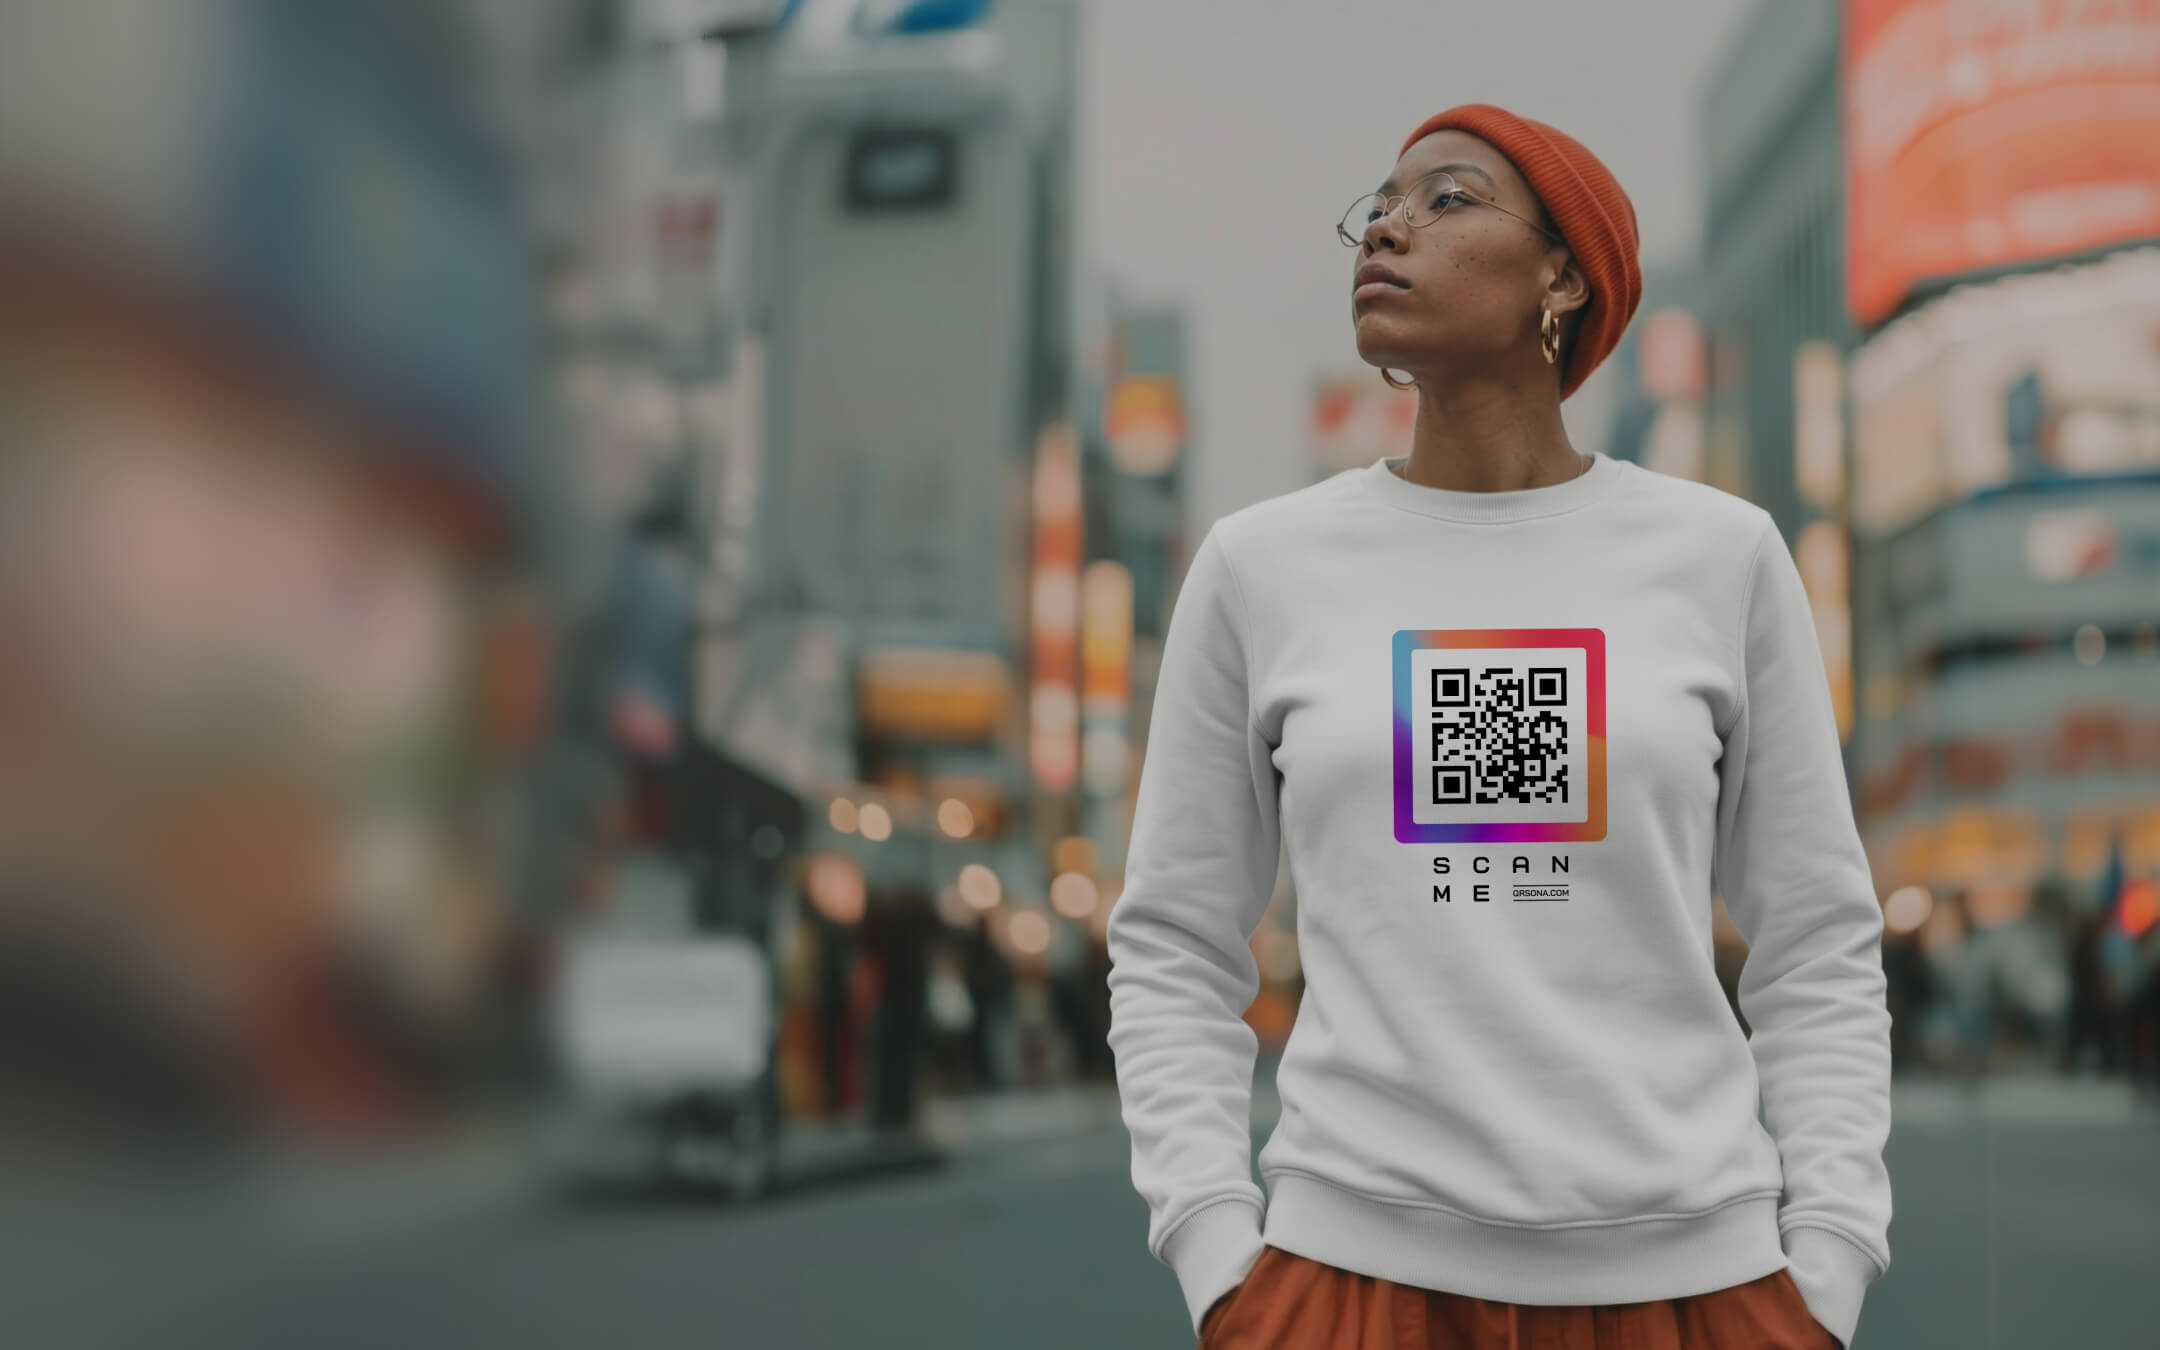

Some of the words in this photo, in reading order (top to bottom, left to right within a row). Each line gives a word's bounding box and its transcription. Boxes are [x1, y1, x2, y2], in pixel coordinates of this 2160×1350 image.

[1433, 856, 1569, 874] SCAN
[1433, 885, 1490, 903] ME
[1512, 889, 1569, 897] QRSONA.COM
